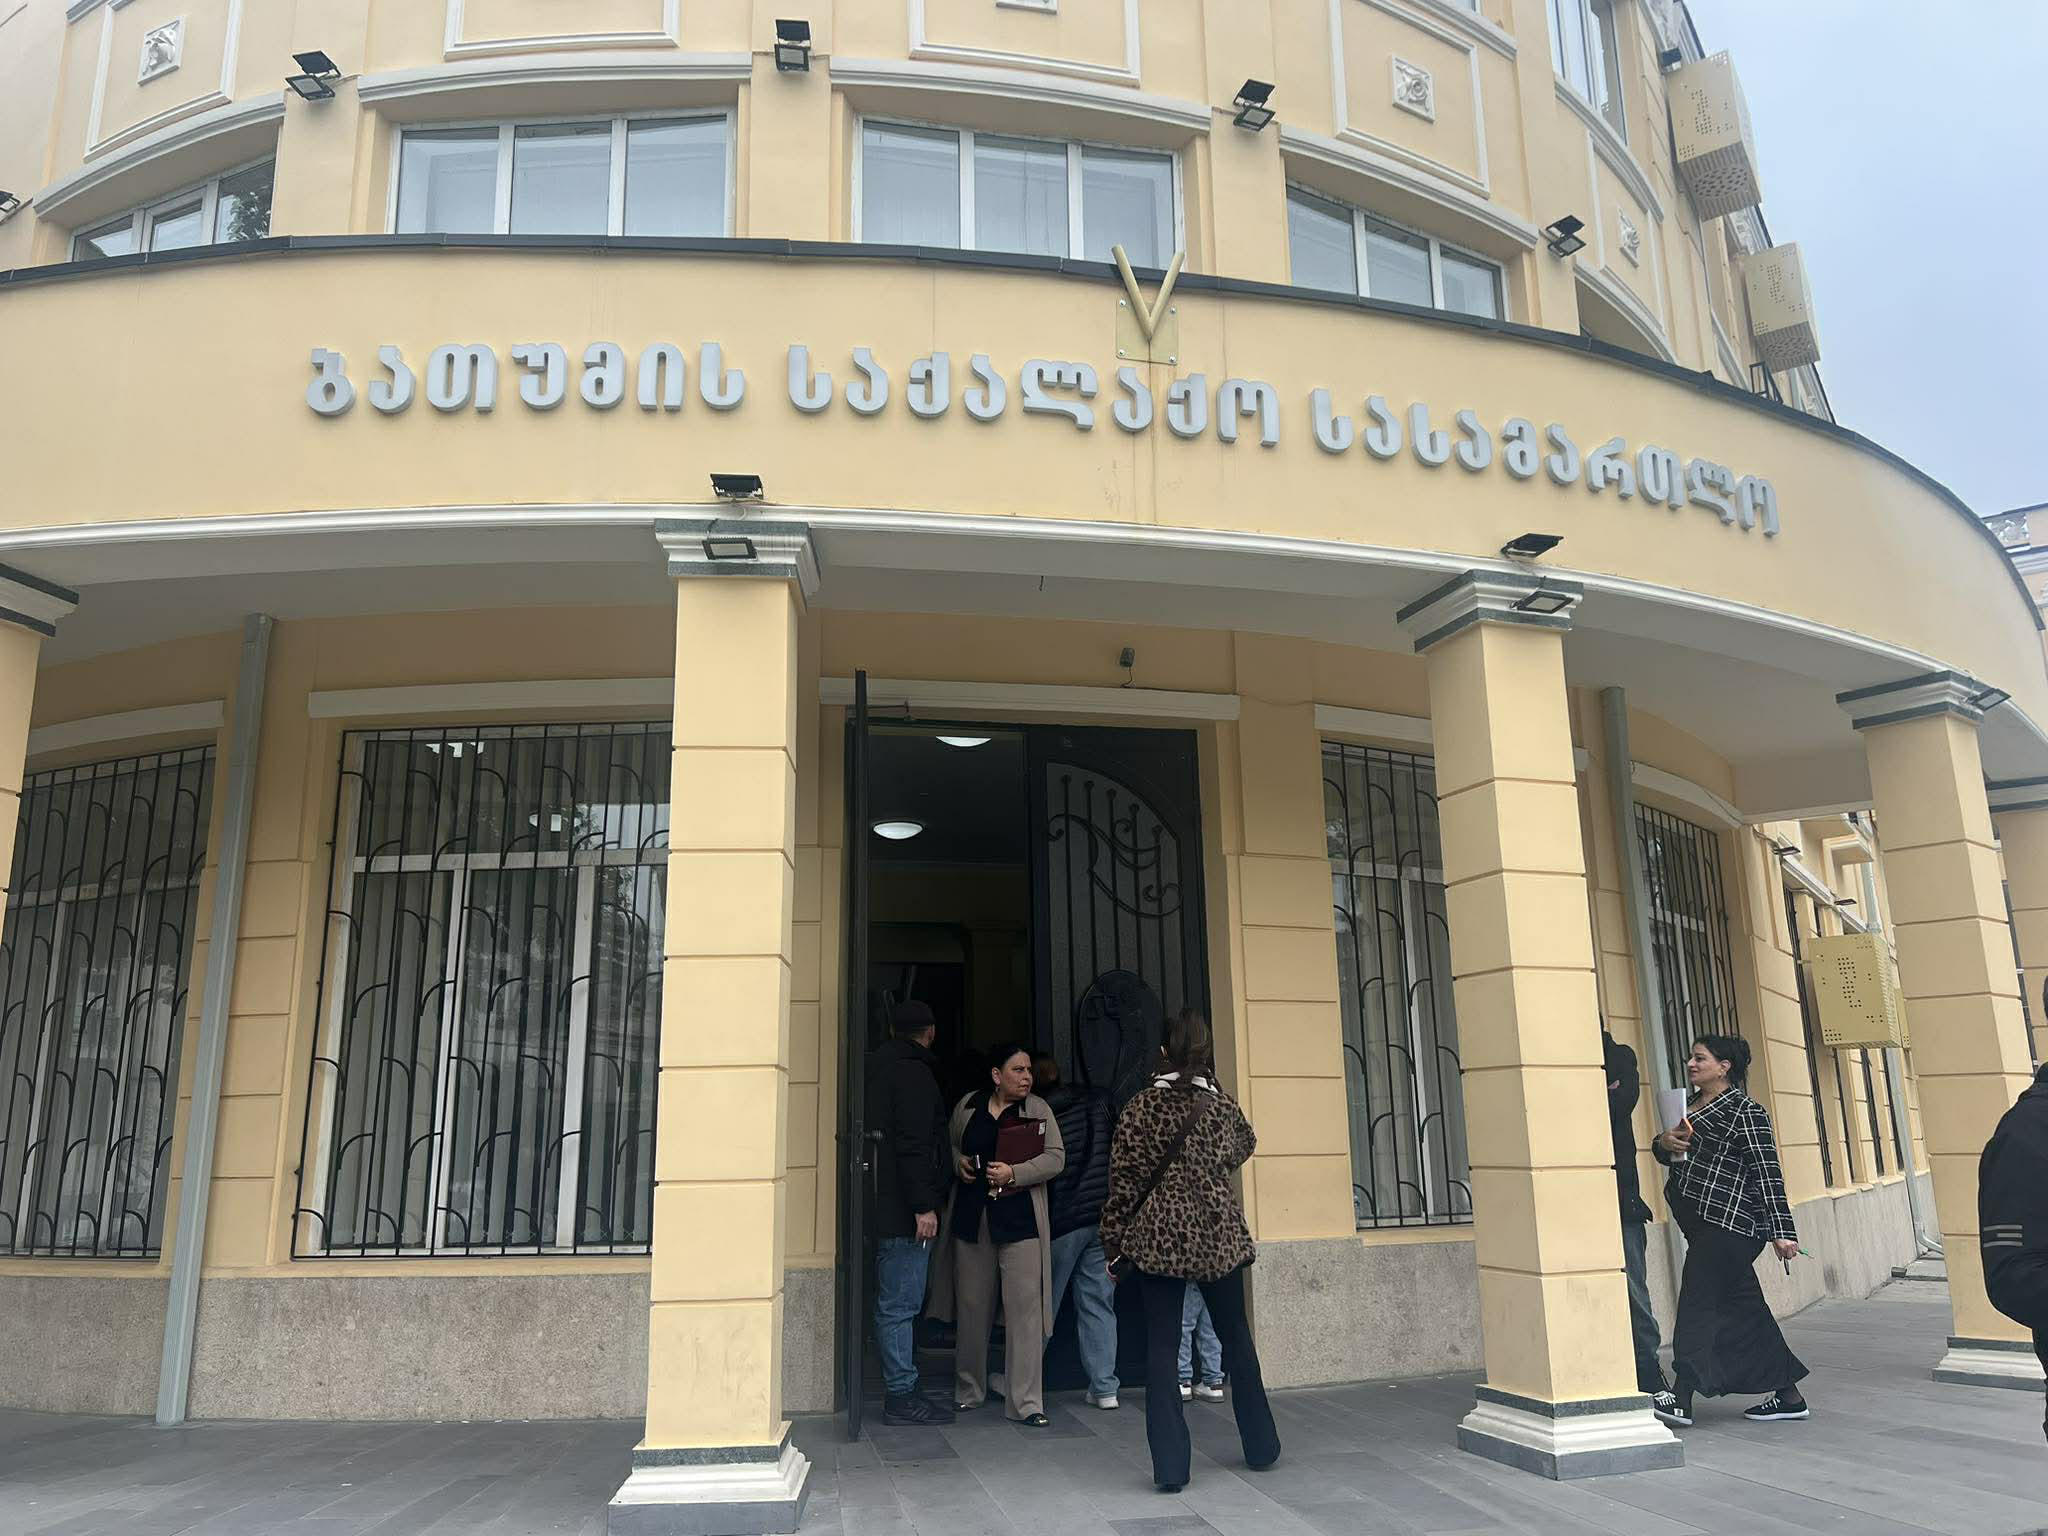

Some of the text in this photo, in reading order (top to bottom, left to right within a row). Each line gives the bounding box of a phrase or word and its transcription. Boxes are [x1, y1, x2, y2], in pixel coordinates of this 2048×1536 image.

[306, 340, 1781, 538] ბათუმის საქალაქო სასამართლო
